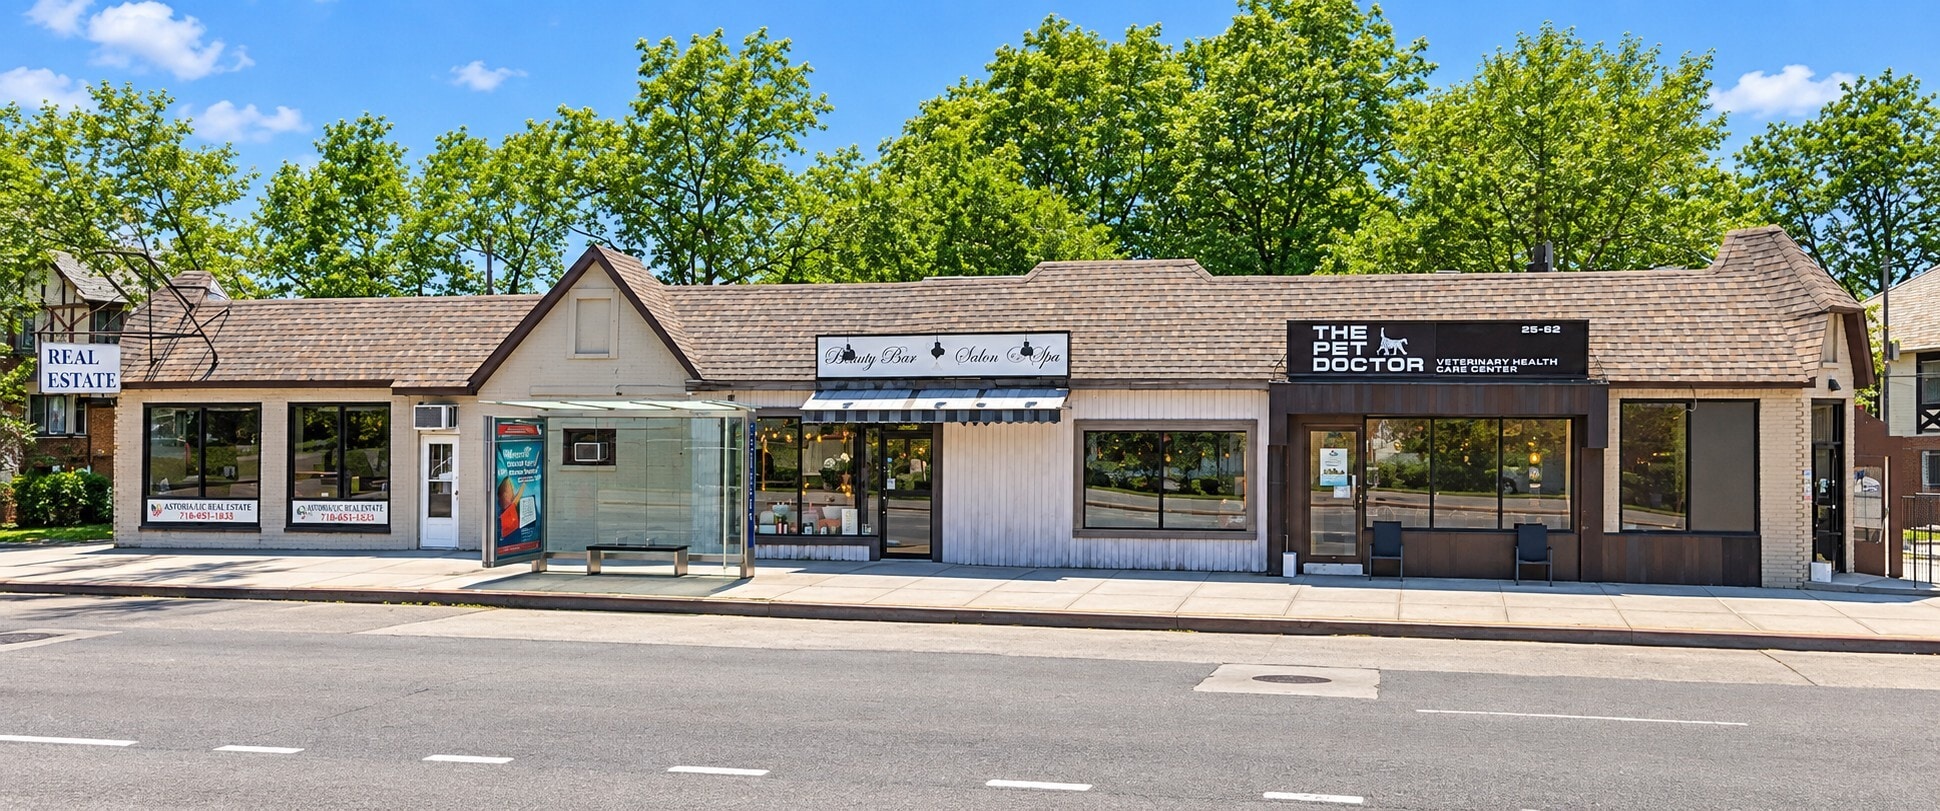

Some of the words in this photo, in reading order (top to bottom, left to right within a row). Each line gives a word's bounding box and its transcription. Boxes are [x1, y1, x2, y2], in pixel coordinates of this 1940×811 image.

[1312, 325, 1368, 340] THE
[1521, 325, 1561, 334] 25-62
[1313, 341, 1368, 356] PET
[48, 349, 100, 365] REAL
[880, 346, 917, 364] Bar
[955, 345, 999, 365] Salon
[1029, 345, 1061, 370] Spa
[1312, 357, 1424, 372] DOCTOR
[1436, 358, 1510, 366] VETERINARY
[1512, 358, 1558, 366] HEALTH
[48, 372, 117, 388] ESTATE
[226, 503, 252, 511] ESTATE
